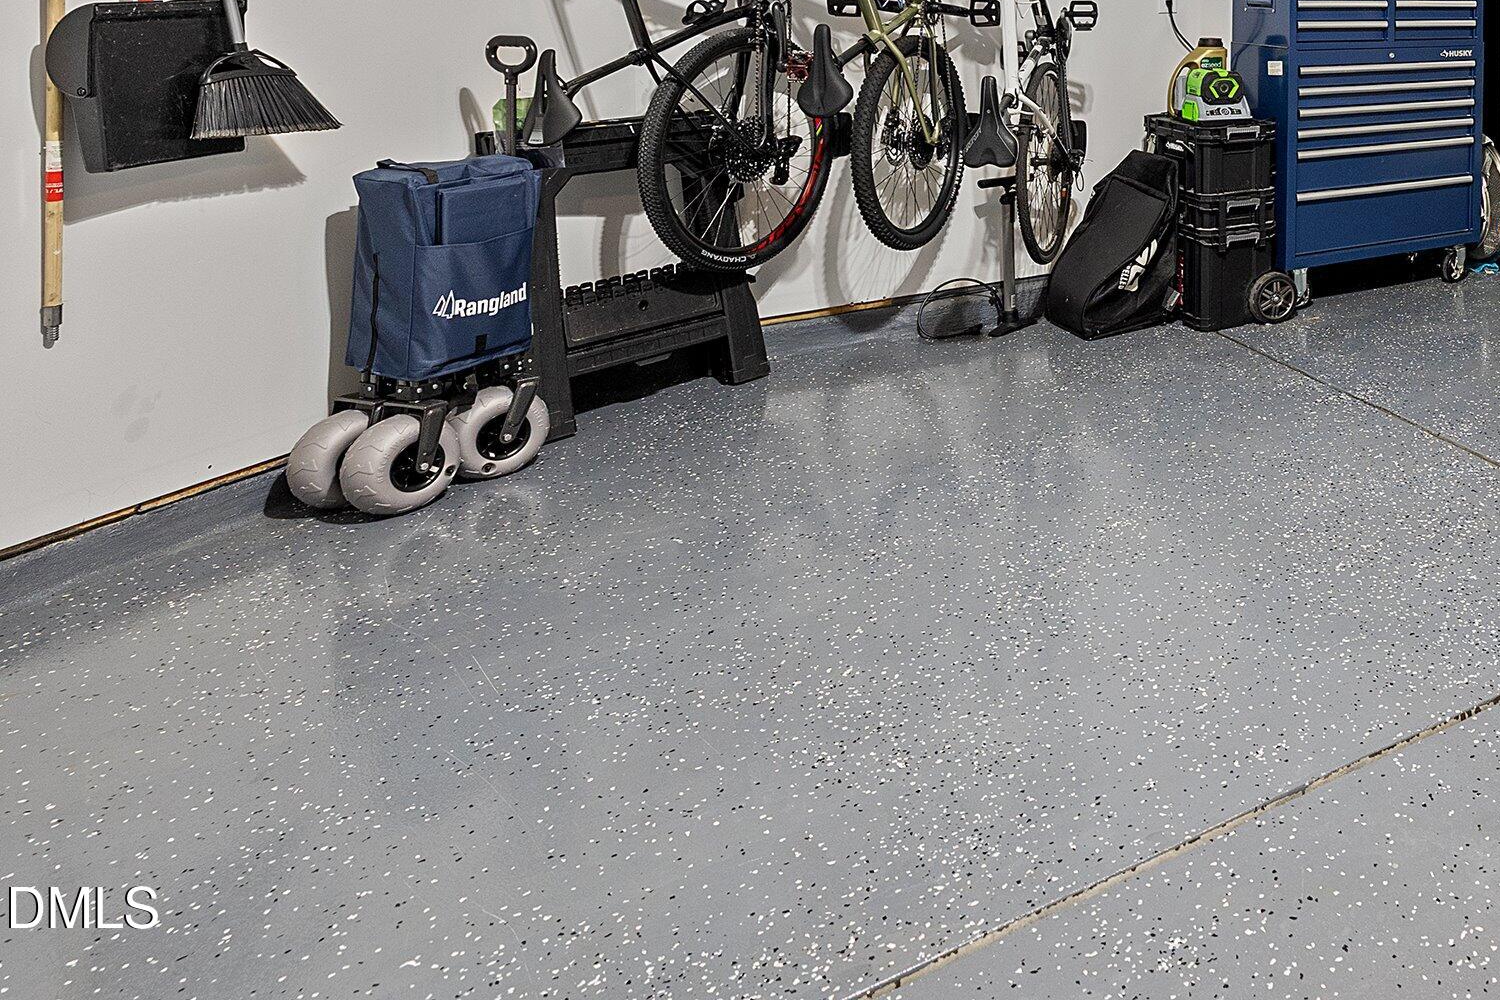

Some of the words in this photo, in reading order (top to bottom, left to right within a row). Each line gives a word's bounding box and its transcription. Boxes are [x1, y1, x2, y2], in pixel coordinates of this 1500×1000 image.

[1448, 49, 1473, 58] HUSKY
[701, 249, 747, 263] CHAOYANG
[454, 281, 527, 318] Rangland
